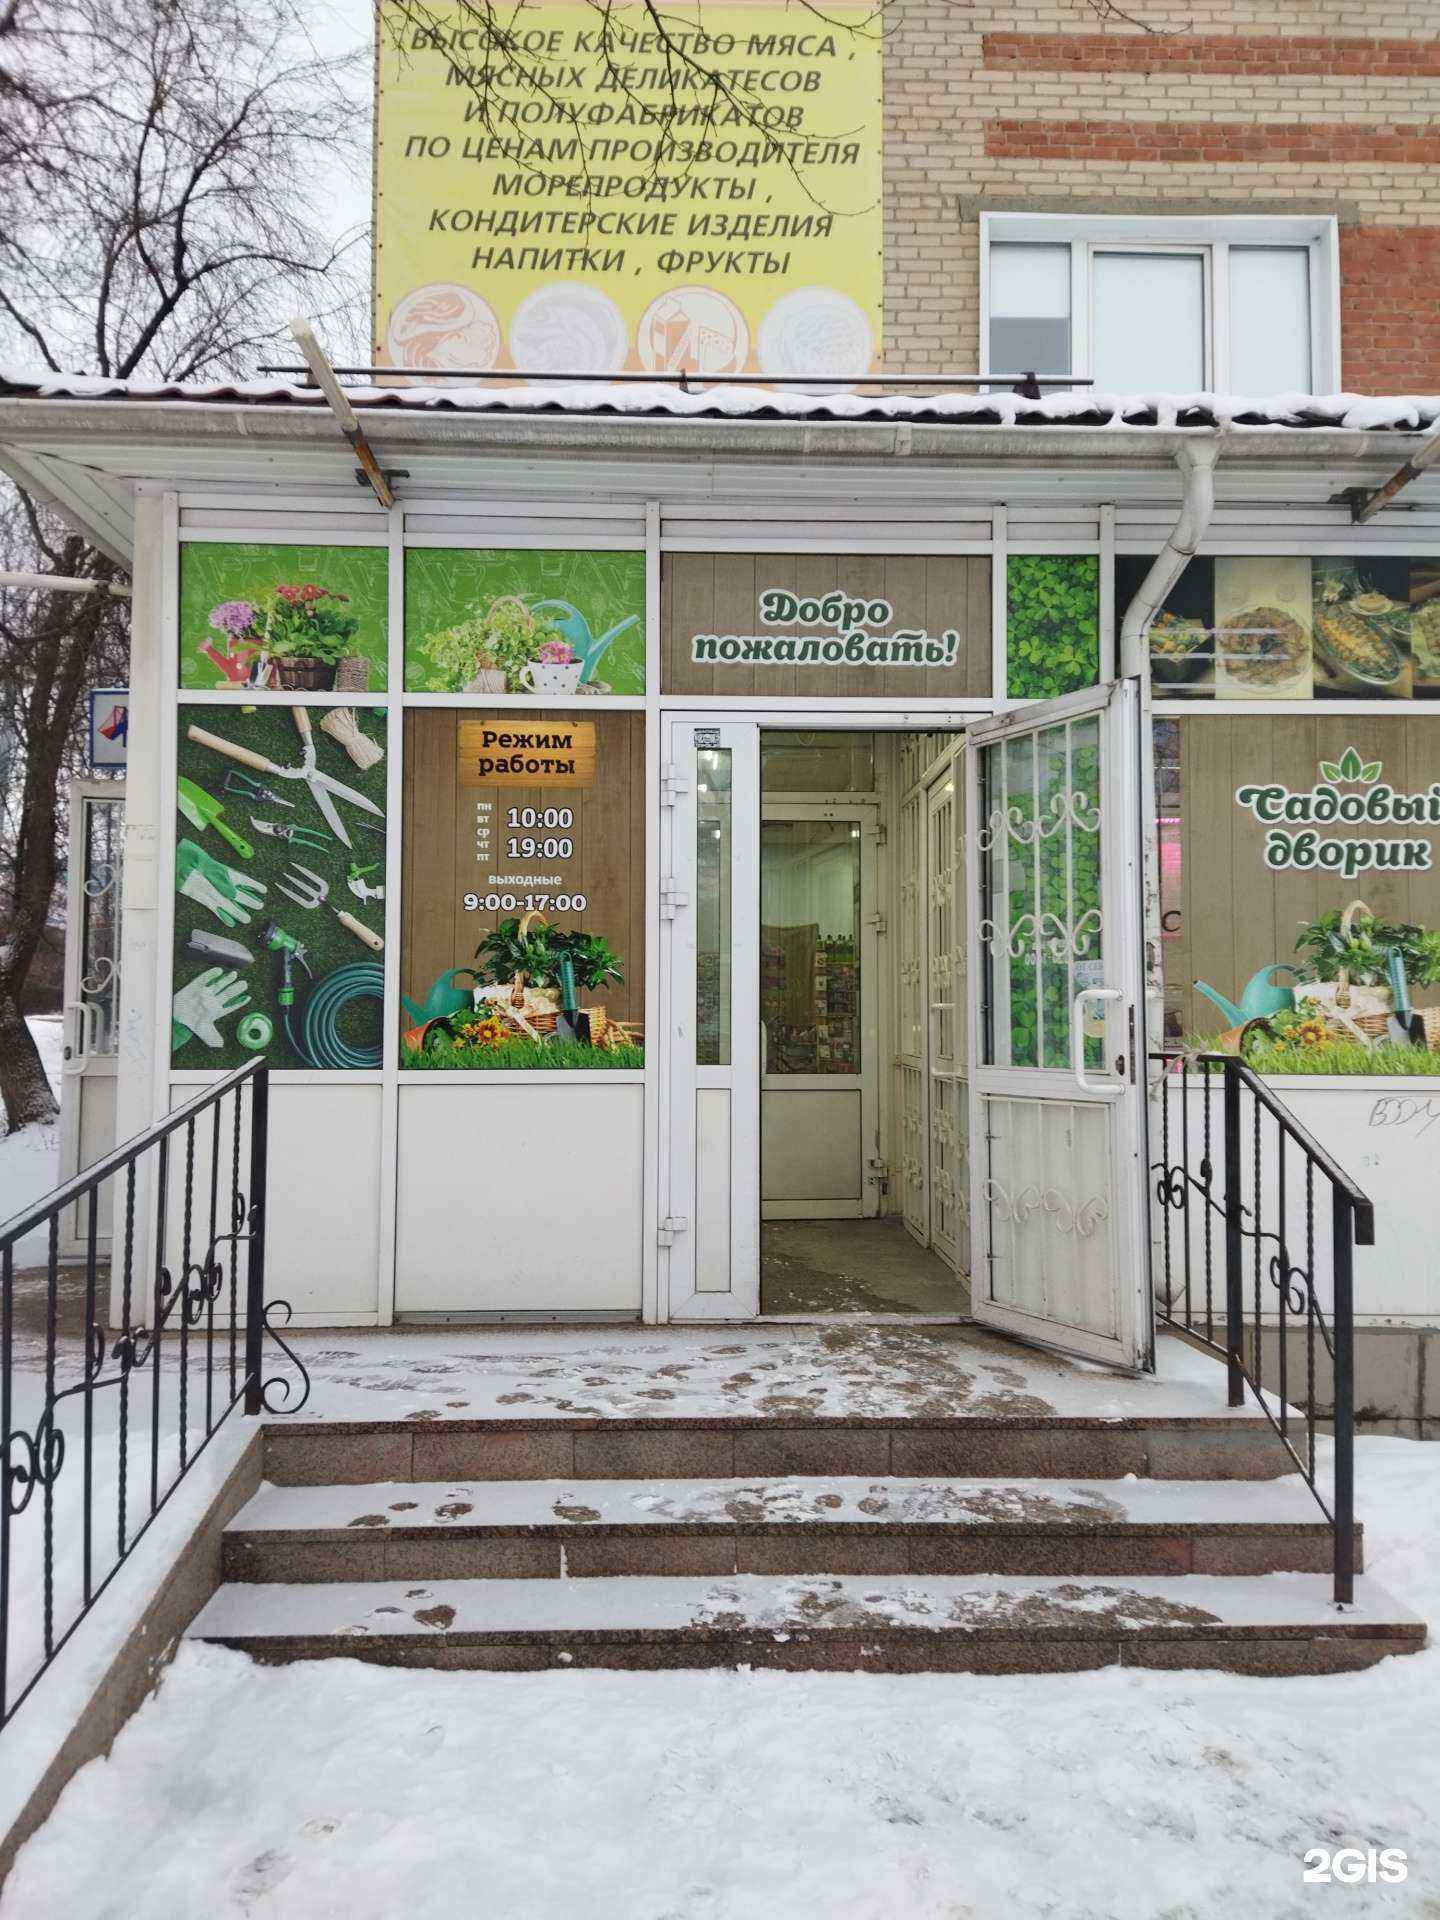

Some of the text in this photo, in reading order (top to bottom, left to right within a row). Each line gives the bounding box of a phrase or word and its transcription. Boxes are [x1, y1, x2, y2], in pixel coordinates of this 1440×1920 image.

[410, 28, 562, 54] ВЫСОКОЕ
[572, 30, 736, 55] КАЧЕСТВО
[445, 67, 822, 93] МЯСНЫХ ДЕЛИКАТЕСОВ
[463, 104, 806, 128] И ПОЛУФАБРИКАТОВ
[404, 136, 861, 167] ПО ЦЕНАМ ПРОИЗВОДИТЕЛЯ
[492, 173, 757, 204] МОРЕПРОДУКТЫ
[428, 208, 834, 240] КОНДИТЕРСКИЕ ИЗДЕЛИЯ
[471, 247, 627, 272] НАПИТКИ
[657, 249, 792, 276] ФРУКТЫ
[761, 589, 891, 631] Добро
[693, 631, 959, 664] пожаловать!
[482, 730, 573, 749] Режим
[478, 754, 576, 776] работы
[477, 803, 492, 811] пн
[507, 807, 574, 829] 10:00
[477, 815, 490, 824] вт
[477, 828, 490, 839] ср
[477, 840, 490, 849] чт
[476, 853, 490, 862] пт
[507, 837, 574, 859] 19:00
[1265, 829, 1432, 878] дворик
[488, 874, 563, 887] выходные
[462, 893, 588, 912] 9:00-17:00
